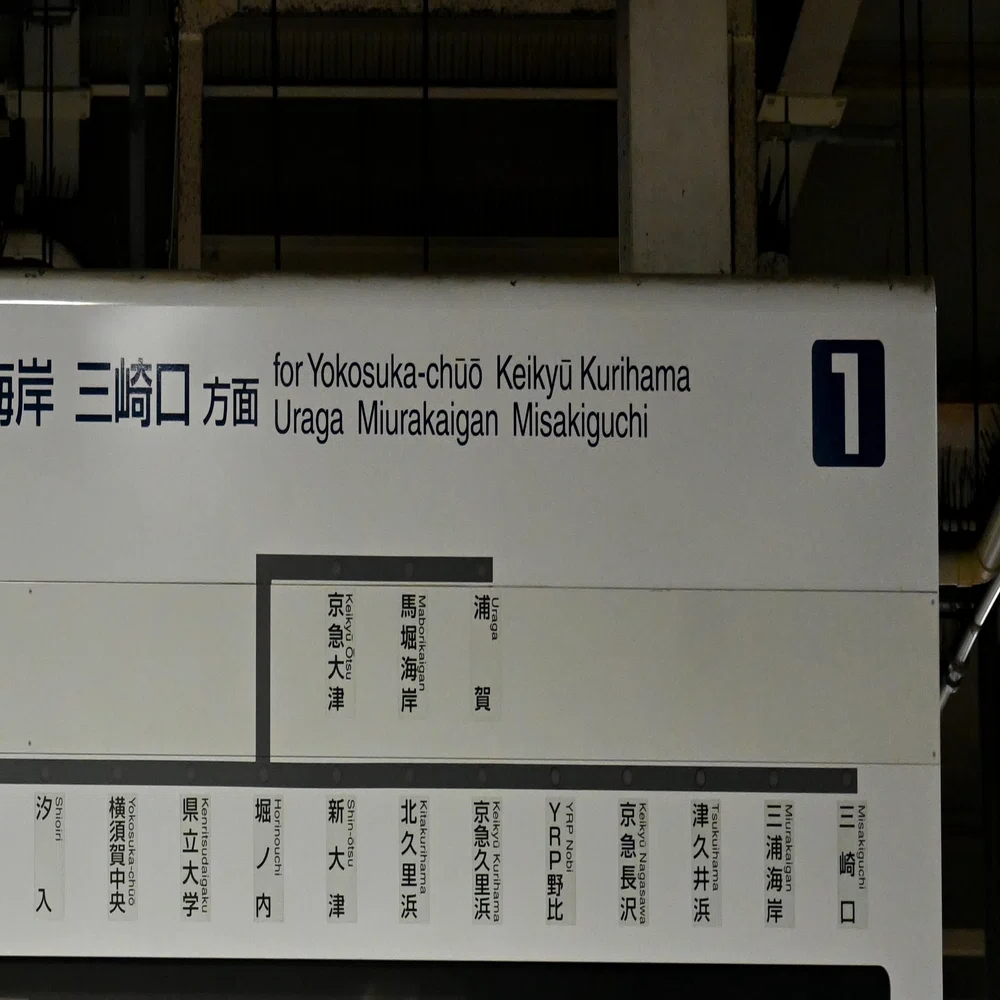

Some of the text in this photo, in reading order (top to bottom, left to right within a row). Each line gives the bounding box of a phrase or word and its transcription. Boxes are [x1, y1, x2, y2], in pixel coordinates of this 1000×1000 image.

[75, 358, 189, 427] 三崎口
[203, 376, 259, 426] 方面
[273, 352, 690, 400] for Yokosuka-chūō Keikyū Kurihama
[275, 398, 647, 447] Uraga Miurakaigan Misakiguchi
[830, 353, 860, 455] 1
[328, 592, 345, 711] 京急大津
[401, 594, 418, 712] 馬堀海岸
[416, 596, 426, 691] Maborikaigan
[474, 595, 491, 711] 浦賀
[489, 598, 499, 640] Uraga
[36, 796, 52, 912] 汐入
[55, 797, 63, 841] Shioiri
[109, 796, 125, 913] 横須賀中央
[183, 798, 198, 917] 県立大学
[200, 798, 209, 912] Kenritsudaigaku
[255, 798, 271, 918] 堀ノ内
[274, 799, 282, 875] Horinouchi
[328, 799, 344, 918] 新大津
[401, 799, 417, 918] 北久里浜
[474, 800, 492, 919] 京急久里浜
[547, 802, 563, 920] YRP野比
[620, 802, 636, 921] 京急長沢
[693, 803, 710, 922] 津久井浜
[767, 805, 783, 923] 三浦海岸
[784, 805, 793, 891] Miurakaigan
[840, 806, 855, 923] 三崎口
[857, 805, 865, 889] Misakiguchi
[638, 853, 647, 924] Nagasawa
